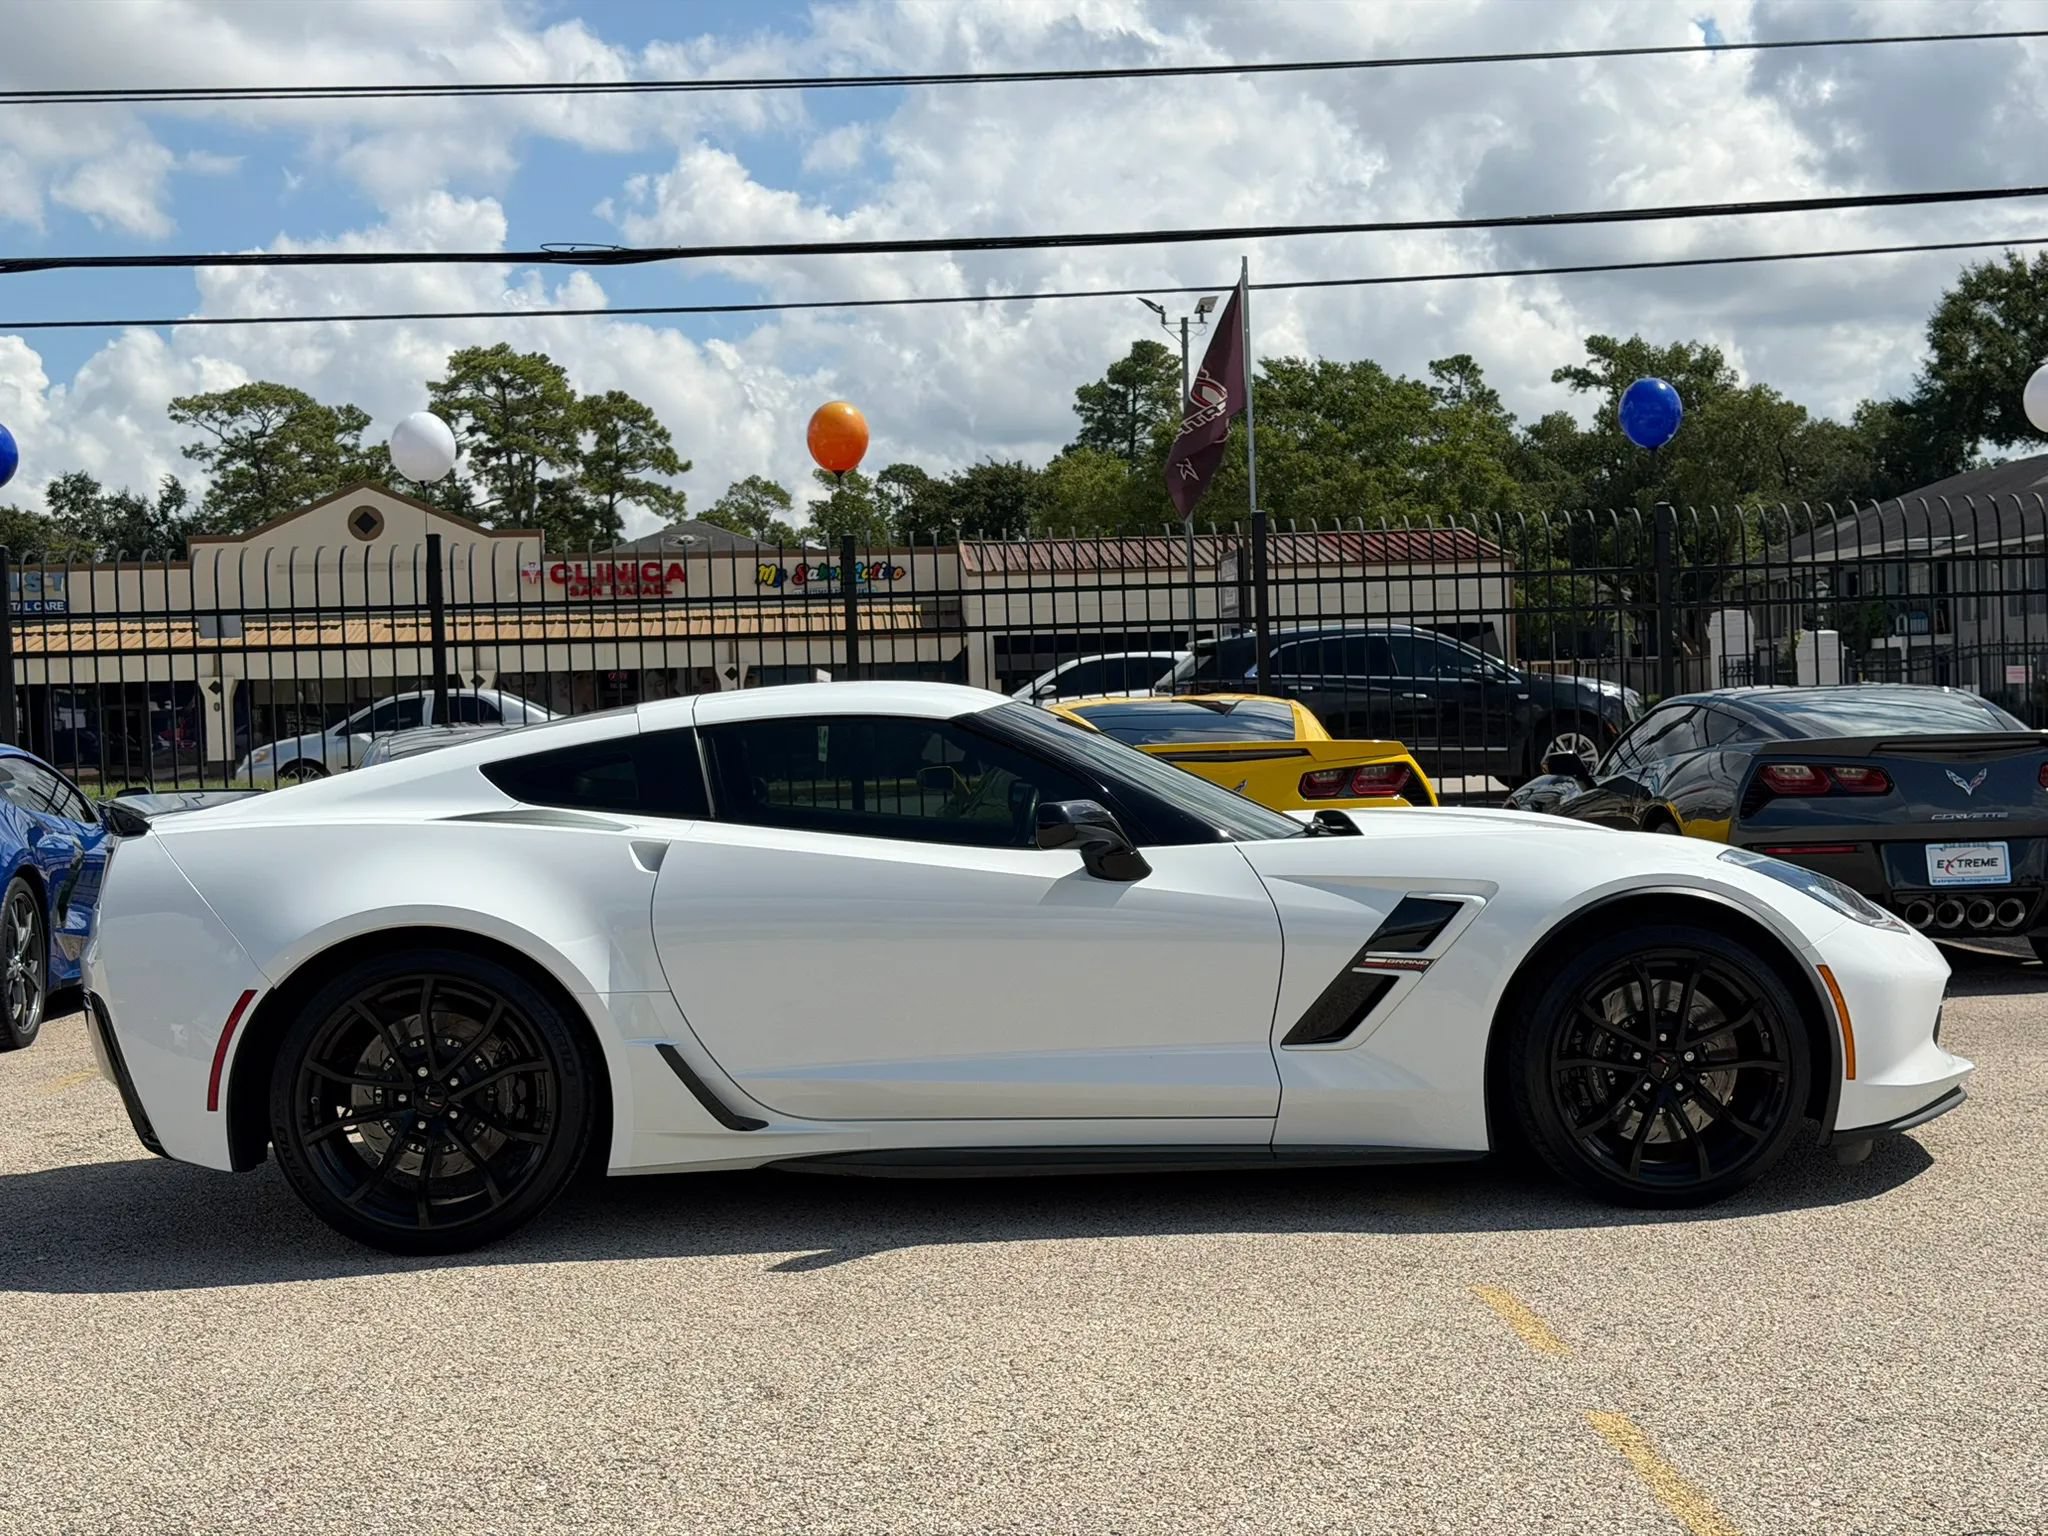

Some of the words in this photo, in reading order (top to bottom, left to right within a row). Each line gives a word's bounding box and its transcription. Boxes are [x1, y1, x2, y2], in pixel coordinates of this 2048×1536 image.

[550, 562, 685, 584] CLINICA
[1931, 812, 2009, 820] CORVETTE
[1936, 858, 1999, 869] EXTREME
[1387, 958, 1429, 966] GRAND
